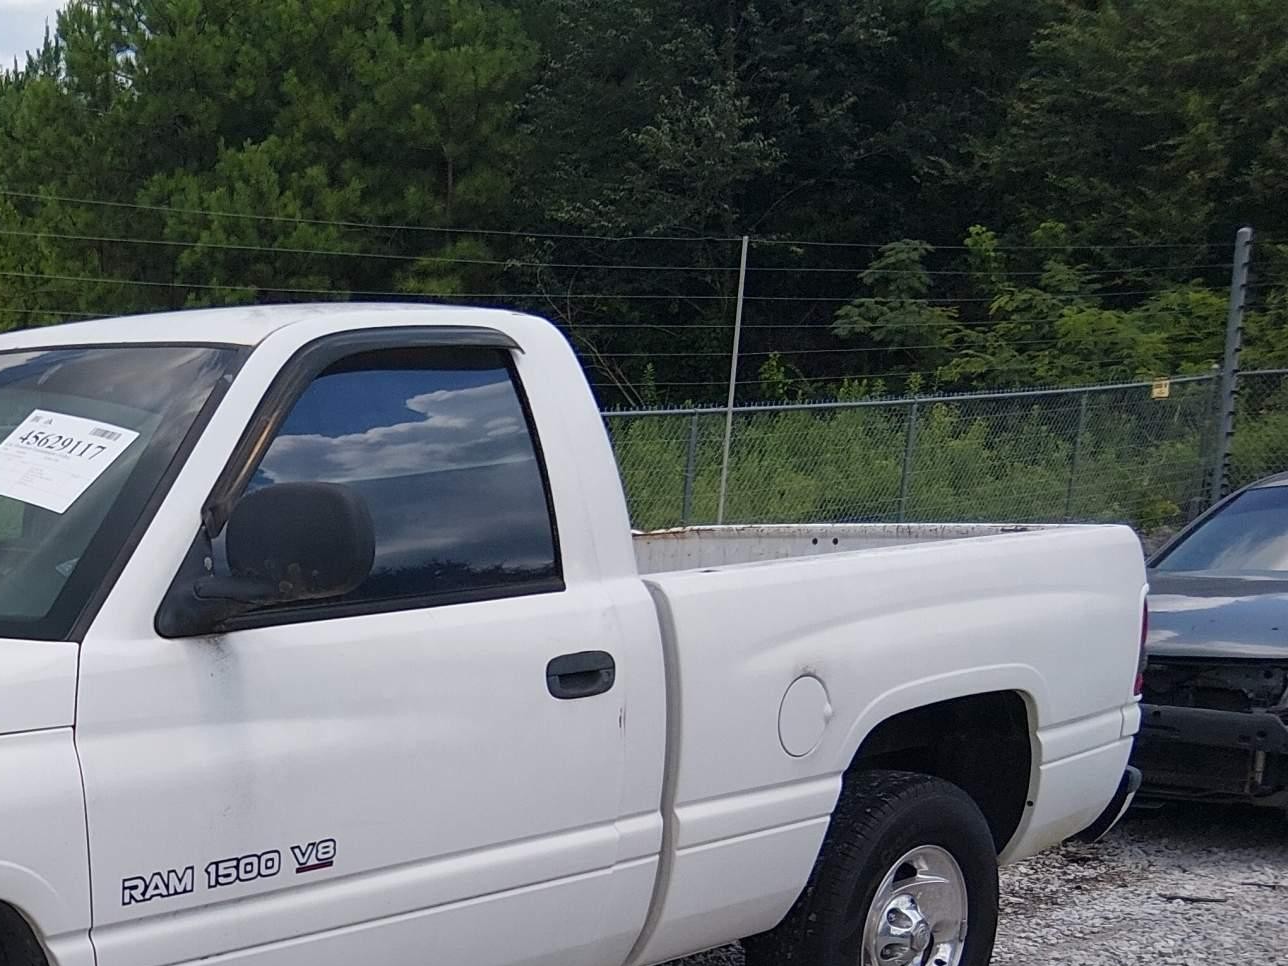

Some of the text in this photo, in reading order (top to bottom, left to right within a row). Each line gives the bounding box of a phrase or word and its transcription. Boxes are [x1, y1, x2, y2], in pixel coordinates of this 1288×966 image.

[19, 430, 108, 460] 45629117
[121, 838, 337, 906] RAM 1500 V8
